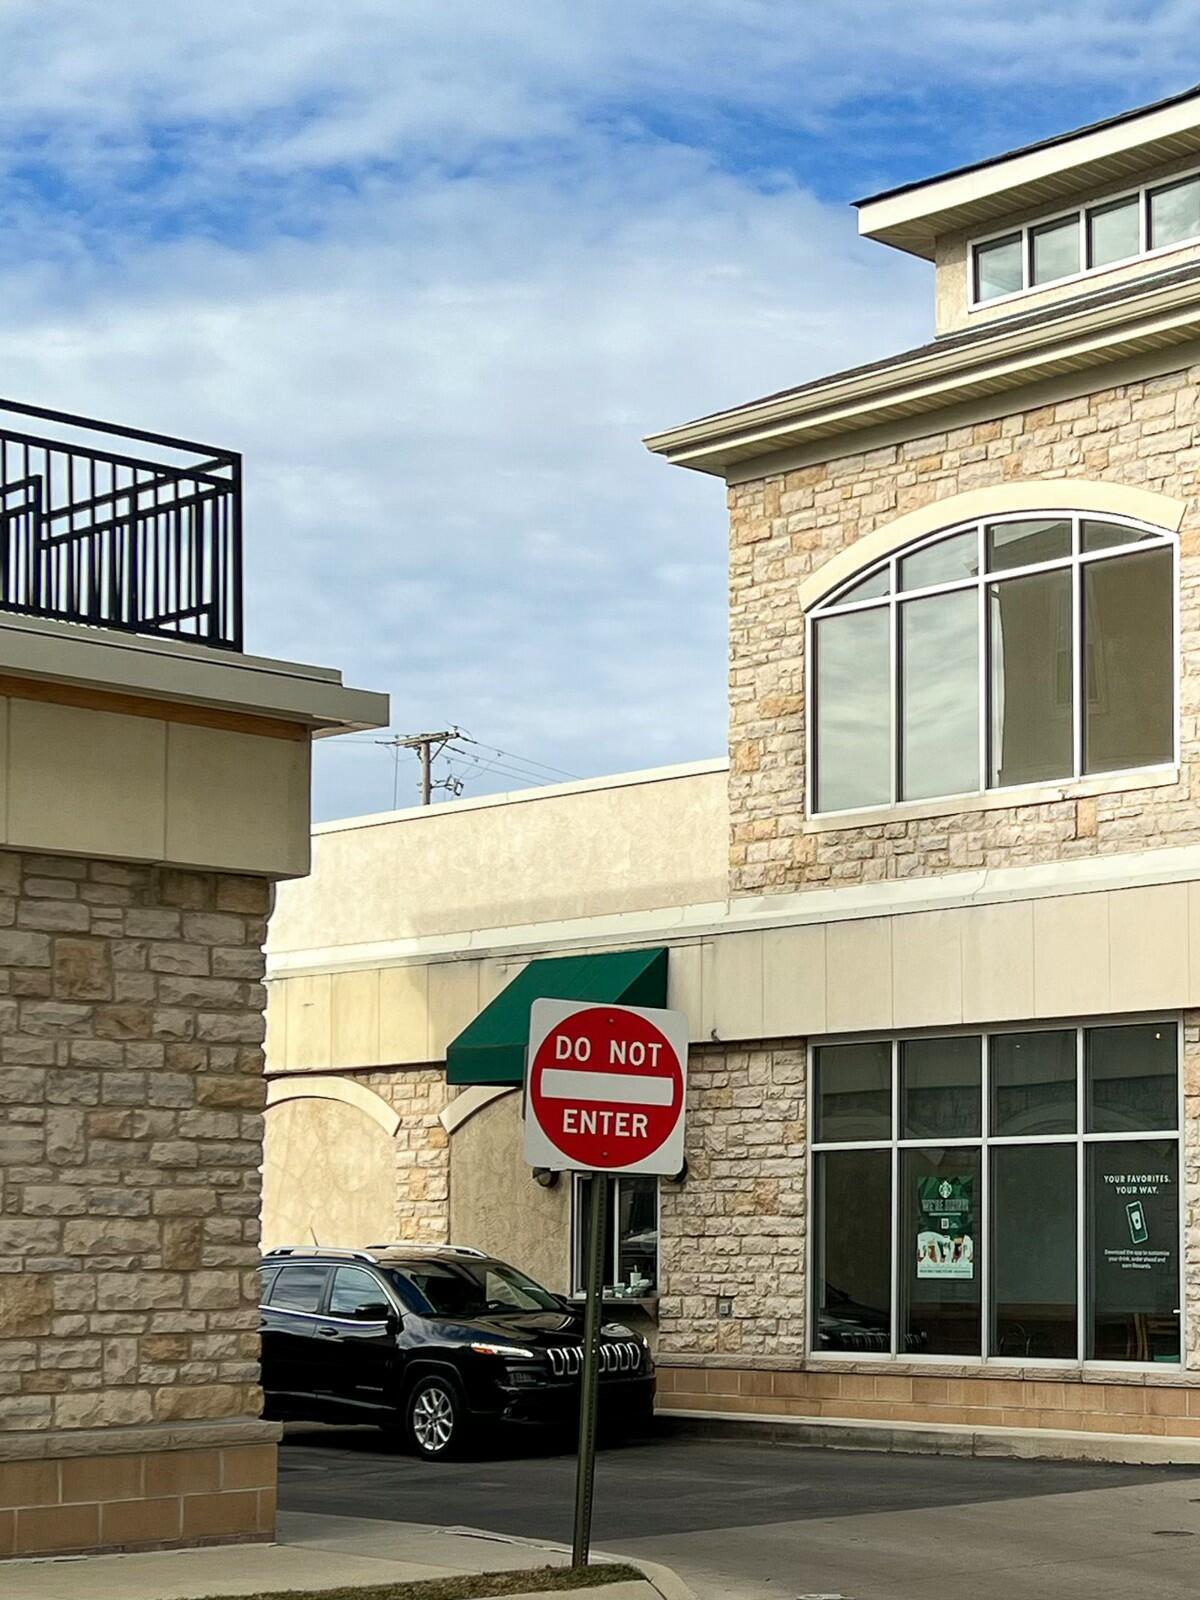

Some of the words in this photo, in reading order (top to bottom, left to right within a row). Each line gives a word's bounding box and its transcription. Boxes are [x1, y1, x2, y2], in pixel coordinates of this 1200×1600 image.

[555, 1035, 591, 1062] DO
[609, 1040, 662, 1067] NOT
[562, 1109, 648, 1138] ENTER
[1104, 1175, 1126, 1183] YOUR
[1127, 1174, 1171, 1183] FAVORITES.
[1116, 1186, 1137, 1194] YOUR
[1139, 1186, 1159, 1194] WAY.
